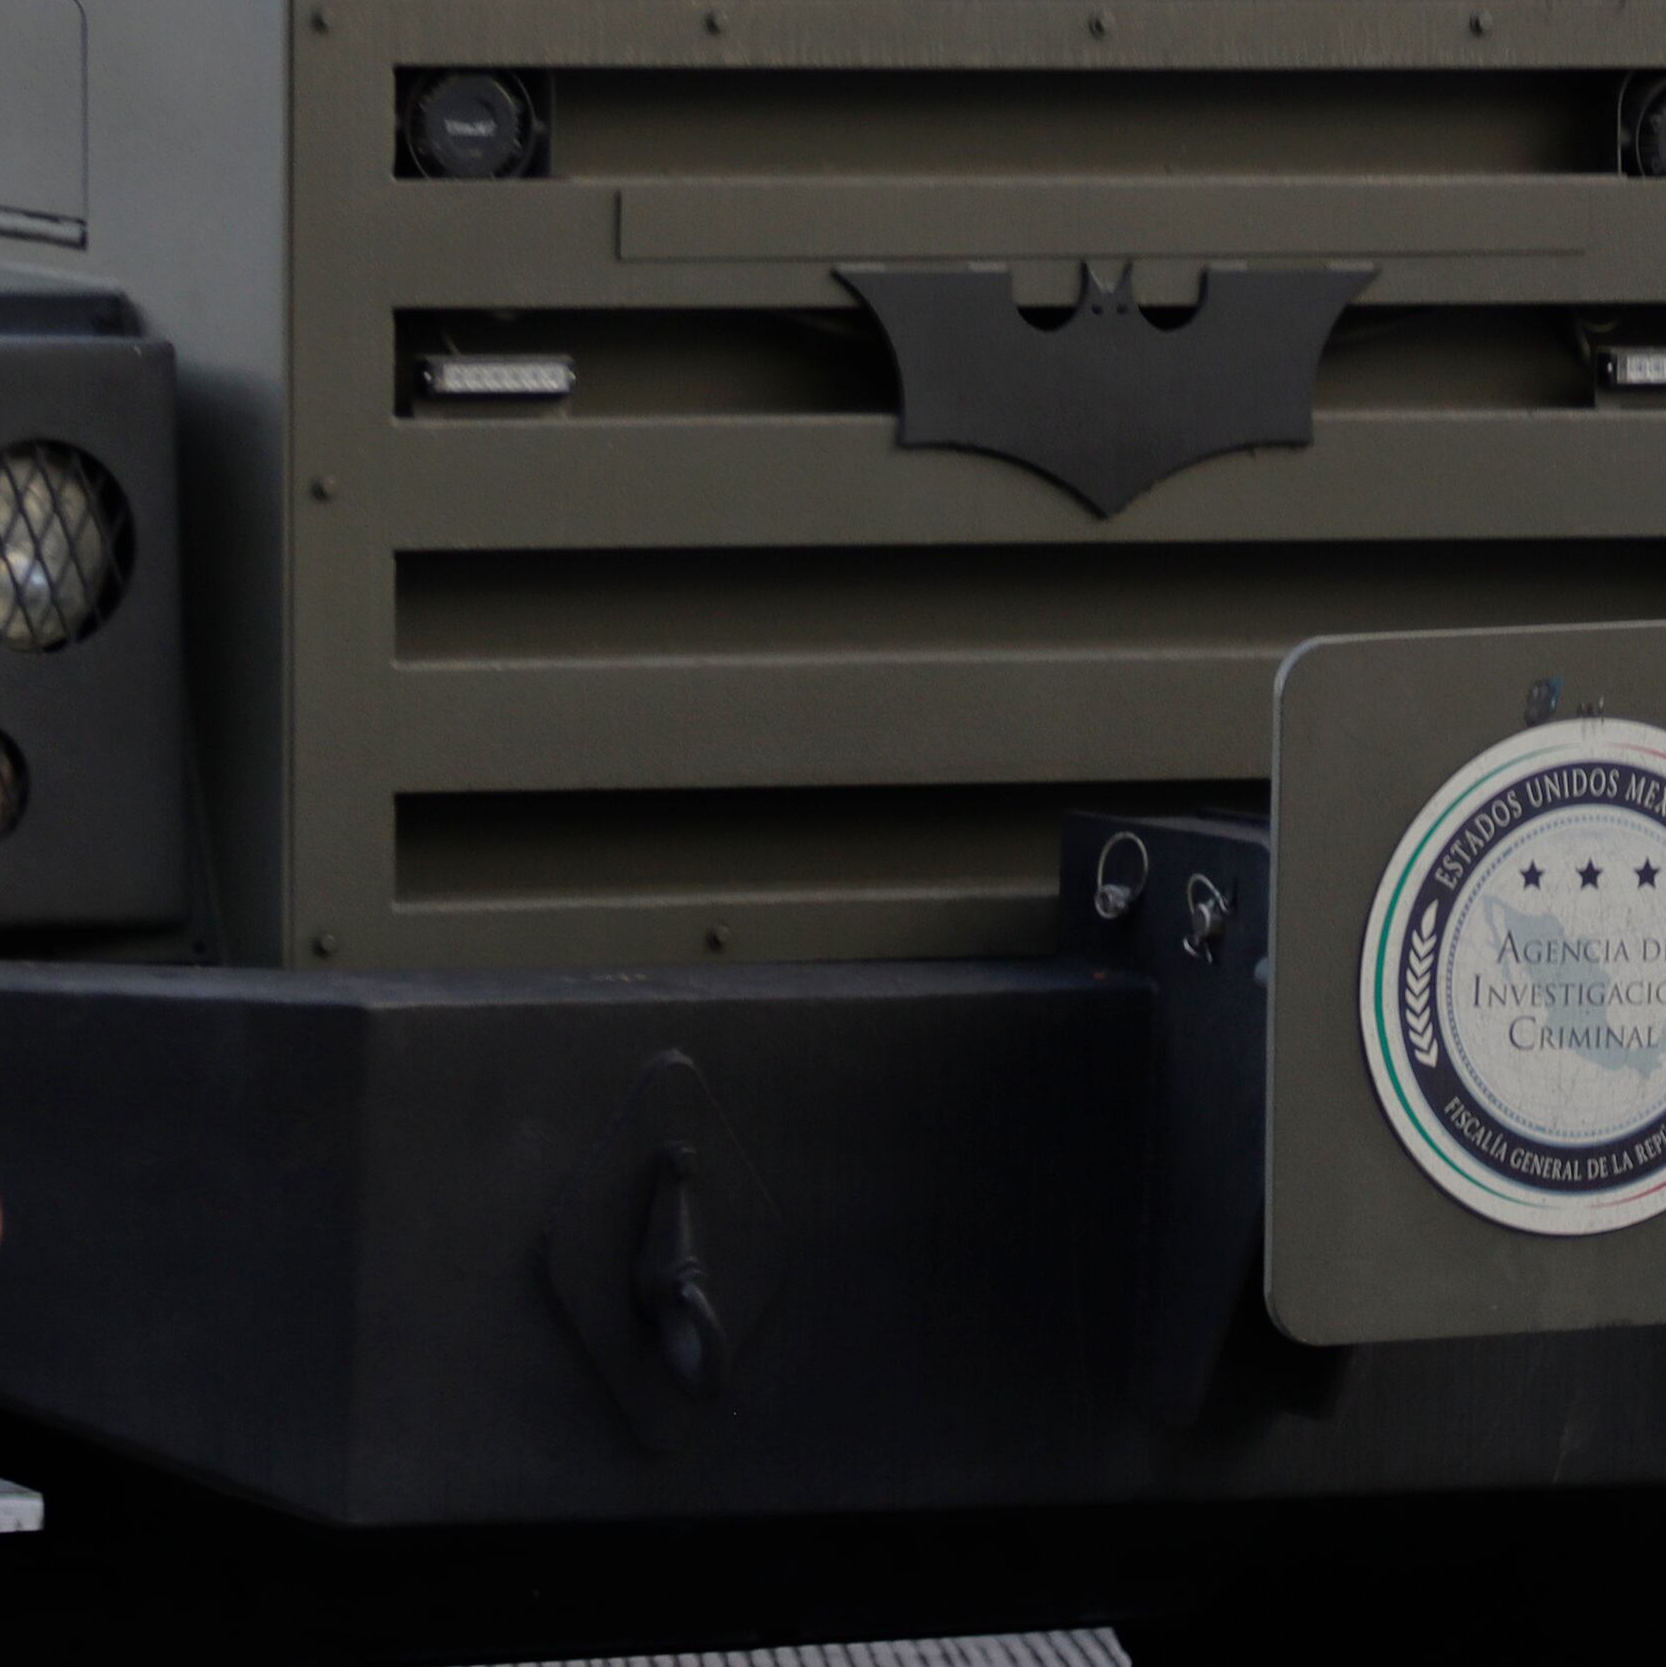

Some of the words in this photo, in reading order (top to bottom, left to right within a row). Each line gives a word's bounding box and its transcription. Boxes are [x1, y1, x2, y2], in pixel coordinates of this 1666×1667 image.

[1434, 789, 1523, 891] ESTADOS
[1526, 767, 1620, 808] UNIDOS
[1509, 1147, 1582, 1181] GENERAL
[1587, 1156, 1608, 1180] DE
[1612, 1150, 1633, 1175] LA
